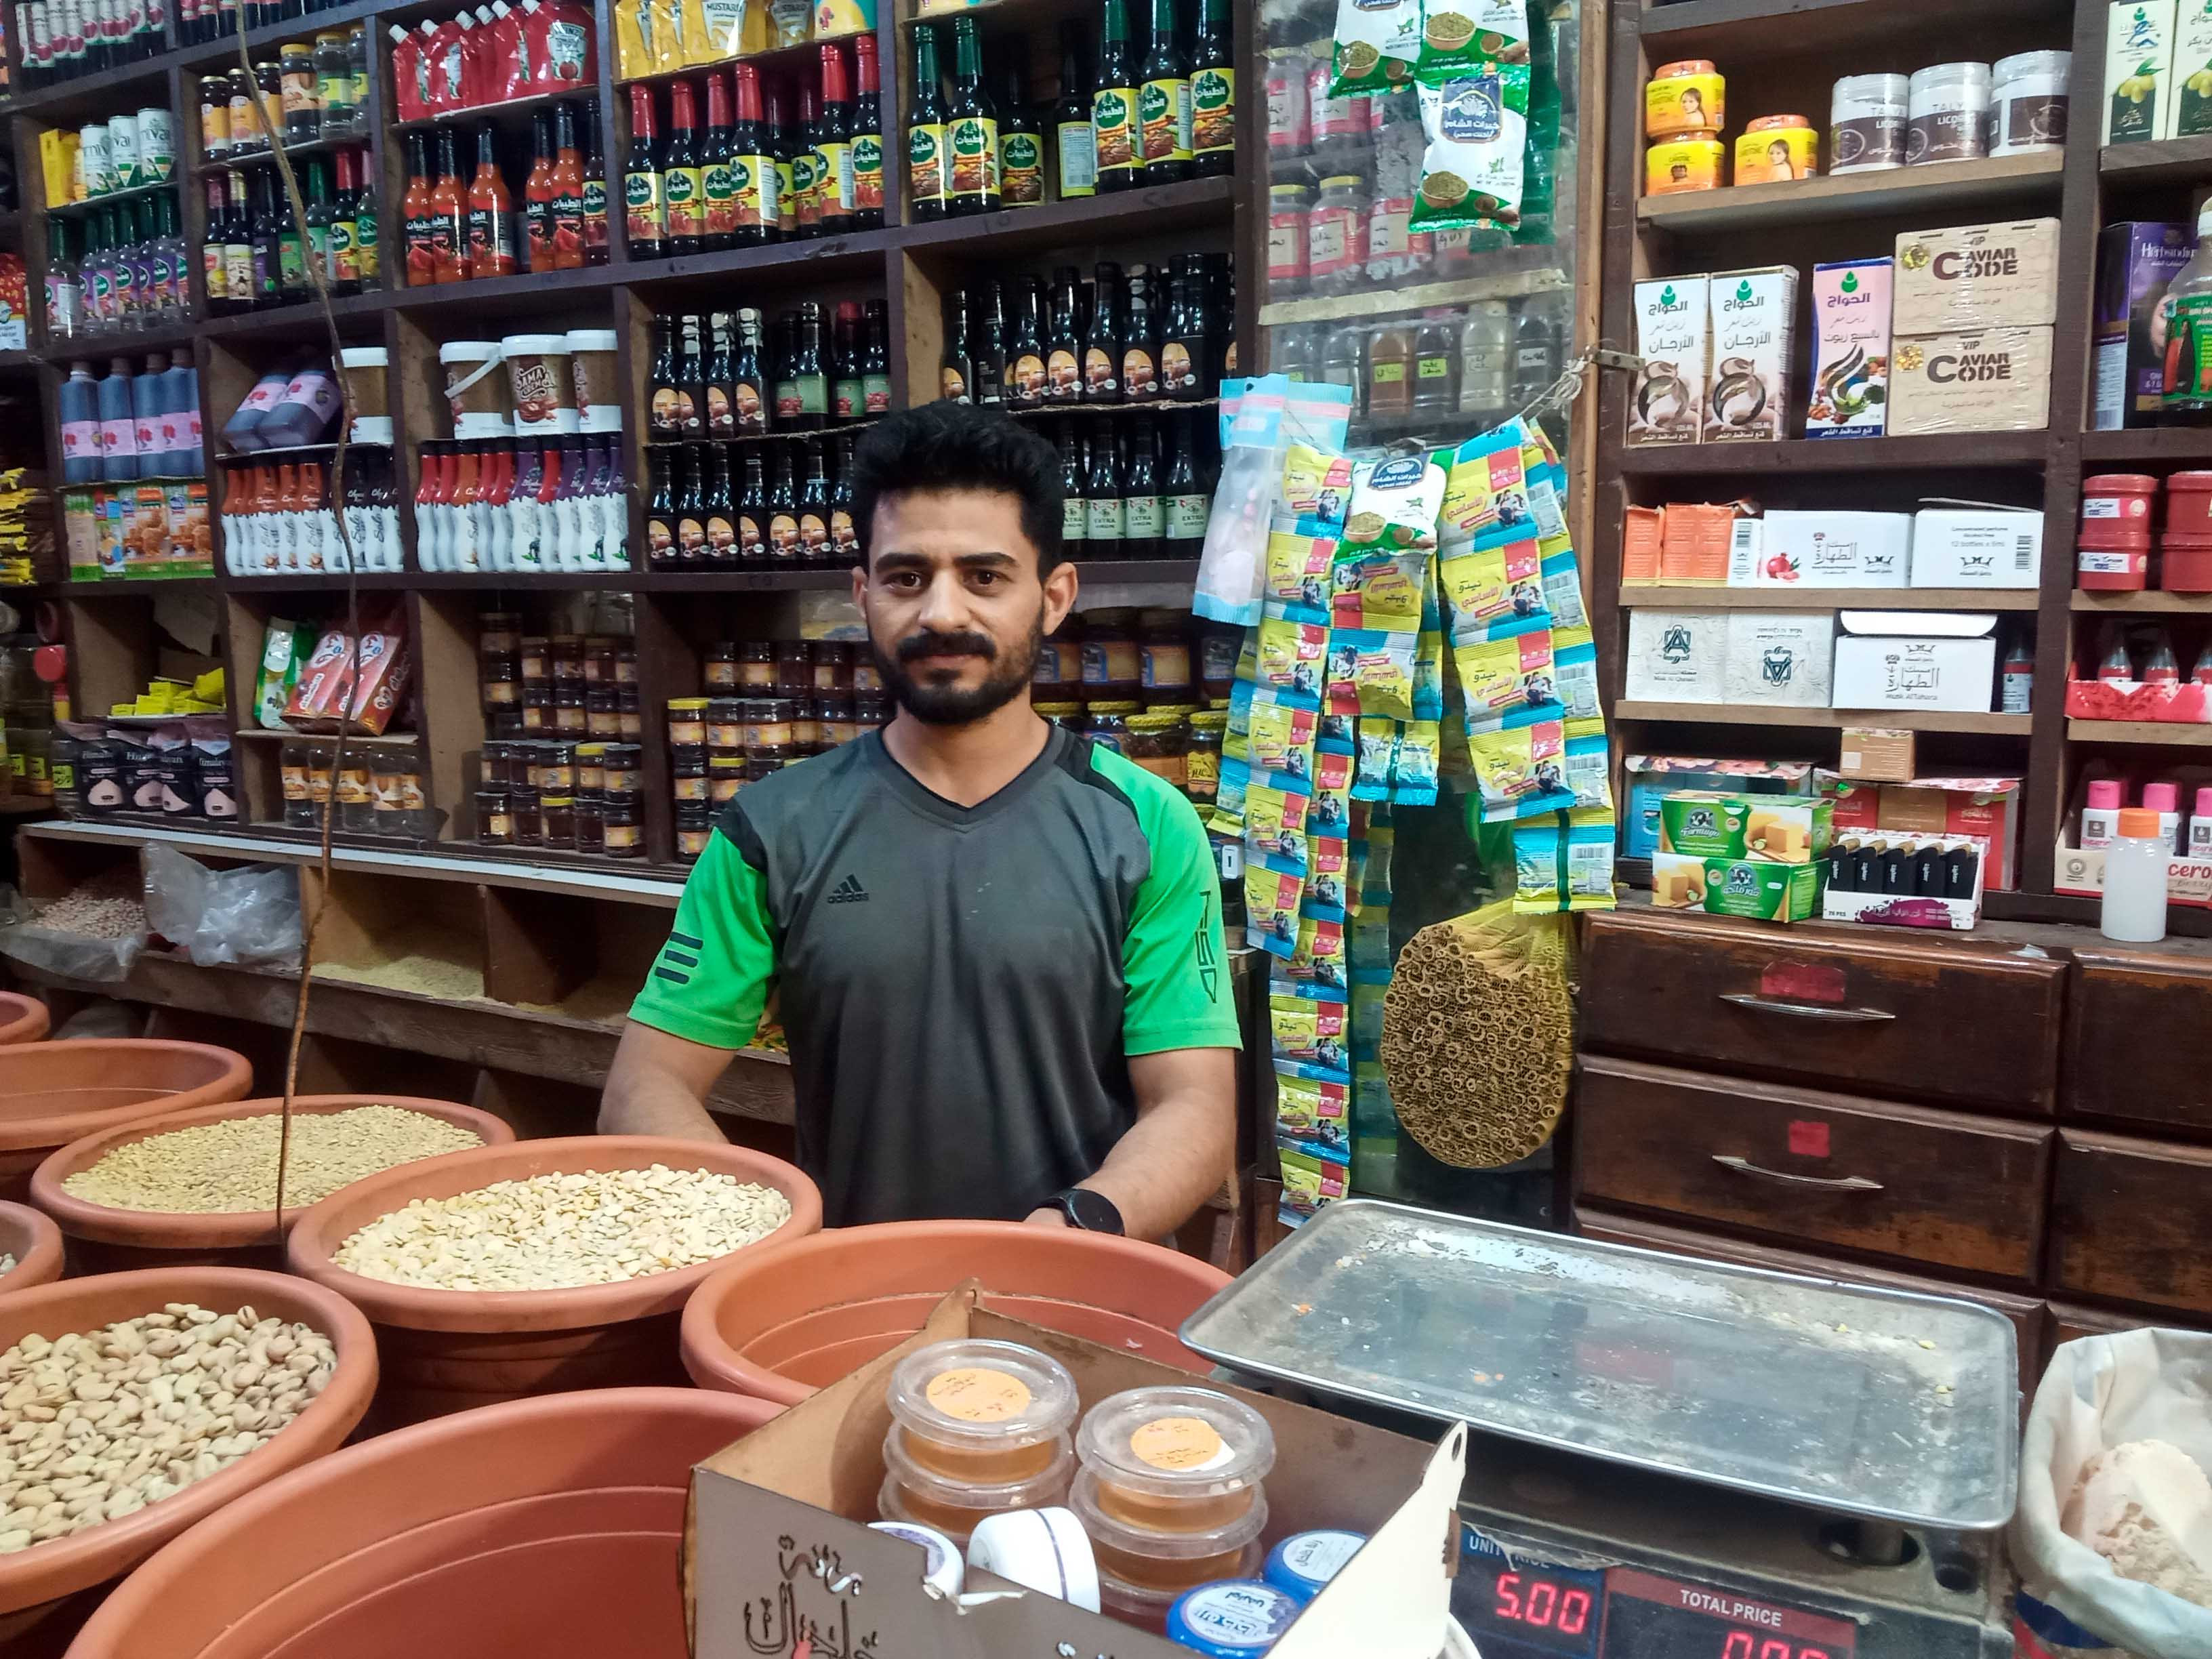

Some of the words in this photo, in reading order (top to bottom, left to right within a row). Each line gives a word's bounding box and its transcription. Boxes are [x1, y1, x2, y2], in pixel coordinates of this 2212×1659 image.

[827, 892, 869, 903] adidas
[1495, 1571, 1591, 1635] 5.00
[1679, 1589, 1730, 1615] TOTAL
[1732, 1600, 1782, 1627] PRICE
